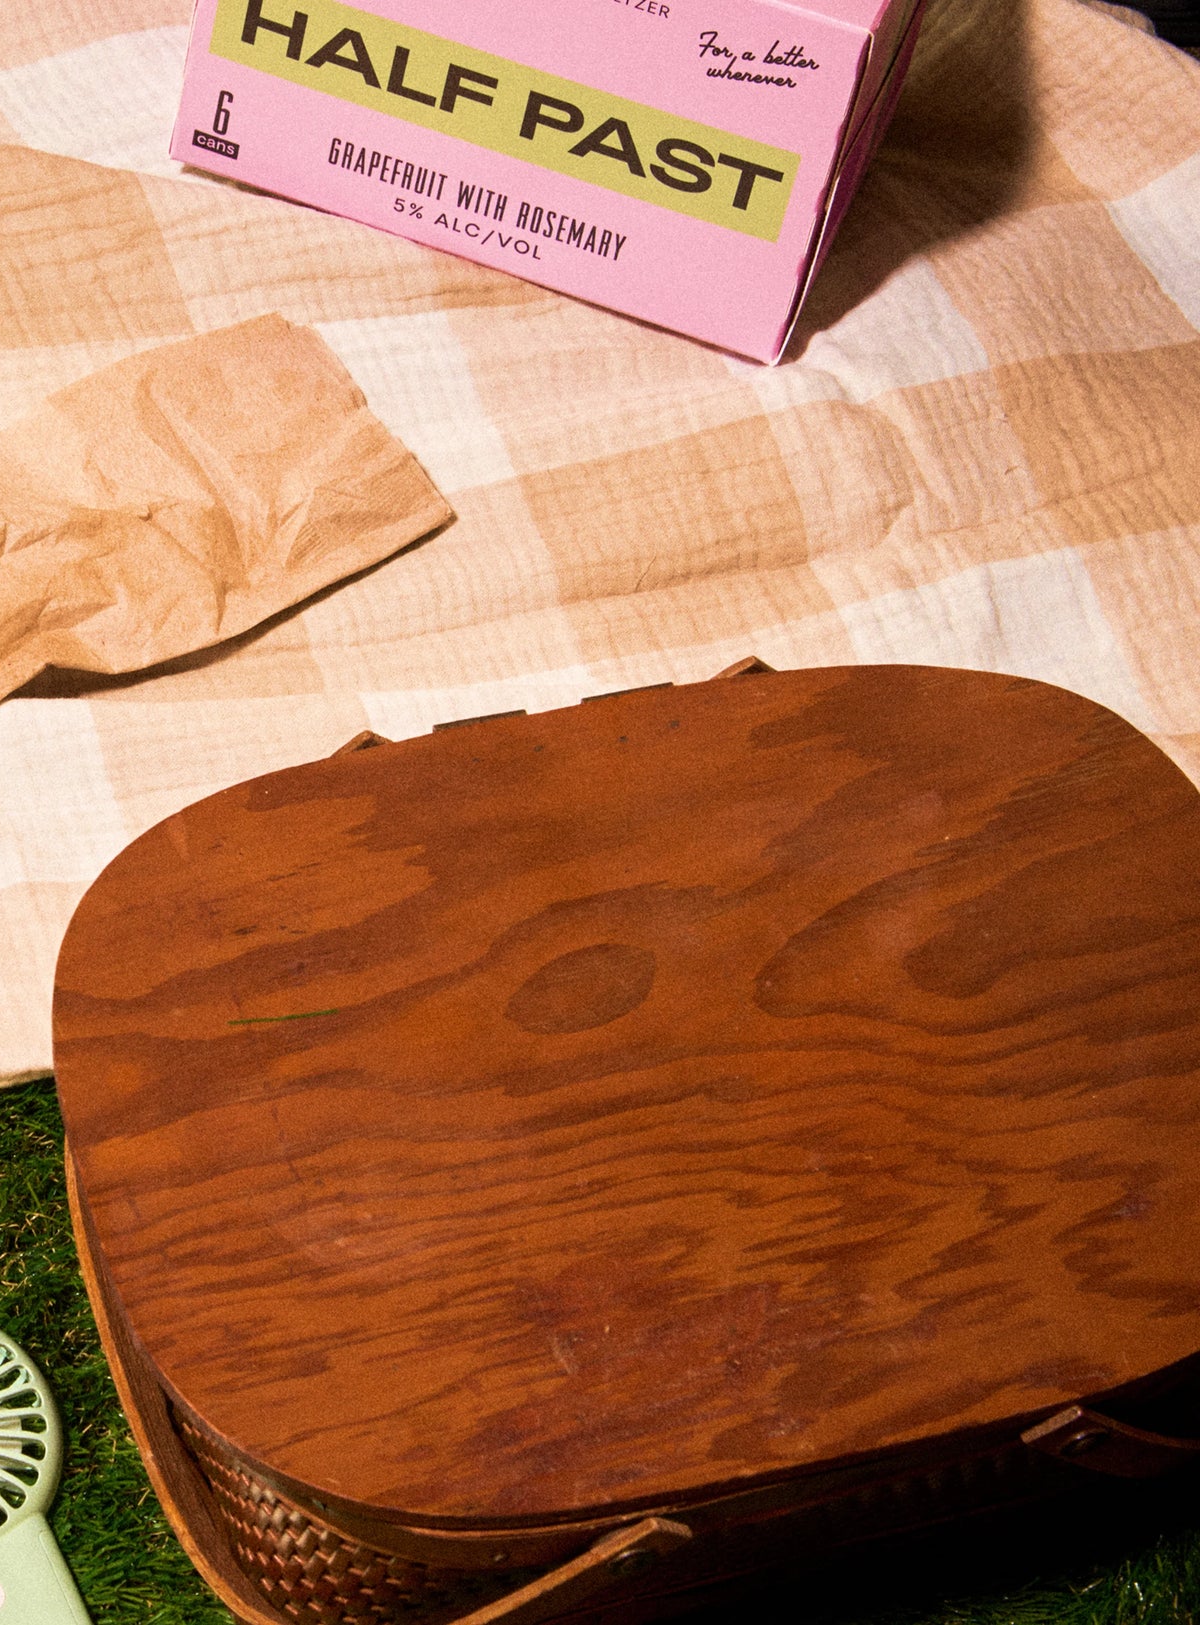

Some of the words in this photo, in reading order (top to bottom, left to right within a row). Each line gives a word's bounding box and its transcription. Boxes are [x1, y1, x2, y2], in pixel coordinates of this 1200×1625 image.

[698, 31, 733, 58] For
[741, 51, 756, 62] a
[763, 40, 820, 70] better
[706, 56, 797, 88] whenever
[212, 89, 234, 136] 6
[241, 0, 499, 113] HALF
[519, 90, 785, 211] PAST
[196, 133, 237, 157] cans
[328, 137, 448, 200] GRAPEFRUIT
[456, 180, 509, 222] WITH
[516, 201, 627, 261] ROSEMARY
[393, 197, 424, 220] 5%
[434, 212, 541, 260] ALC/VOL
